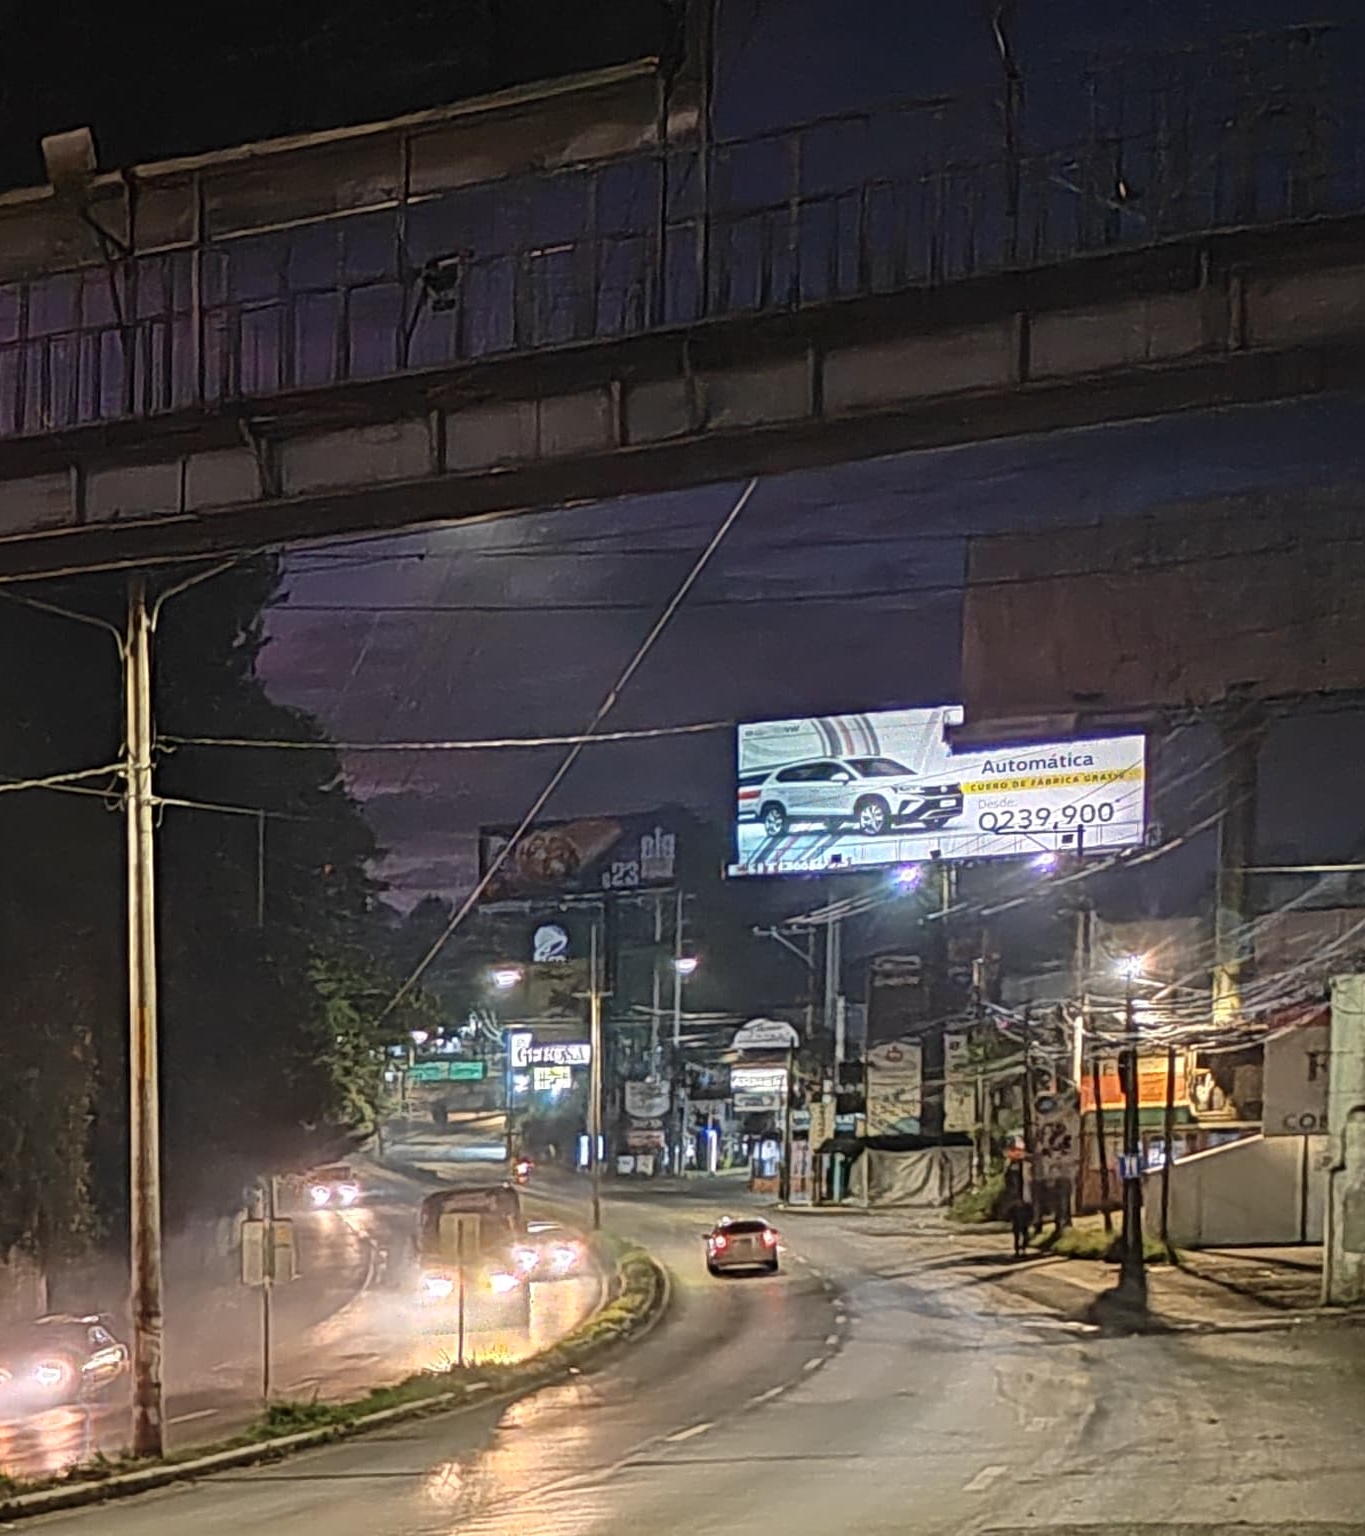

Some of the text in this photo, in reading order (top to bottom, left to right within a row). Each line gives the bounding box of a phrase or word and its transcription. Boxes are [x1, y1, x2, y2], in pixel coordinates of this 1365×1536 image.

[981, 753, 1094, 775] Automática
[970, 781, 1009, 793] CUERO
[1012, 779, 1027, 789] DE
[978, 803, 1114, 833] Q239,900
